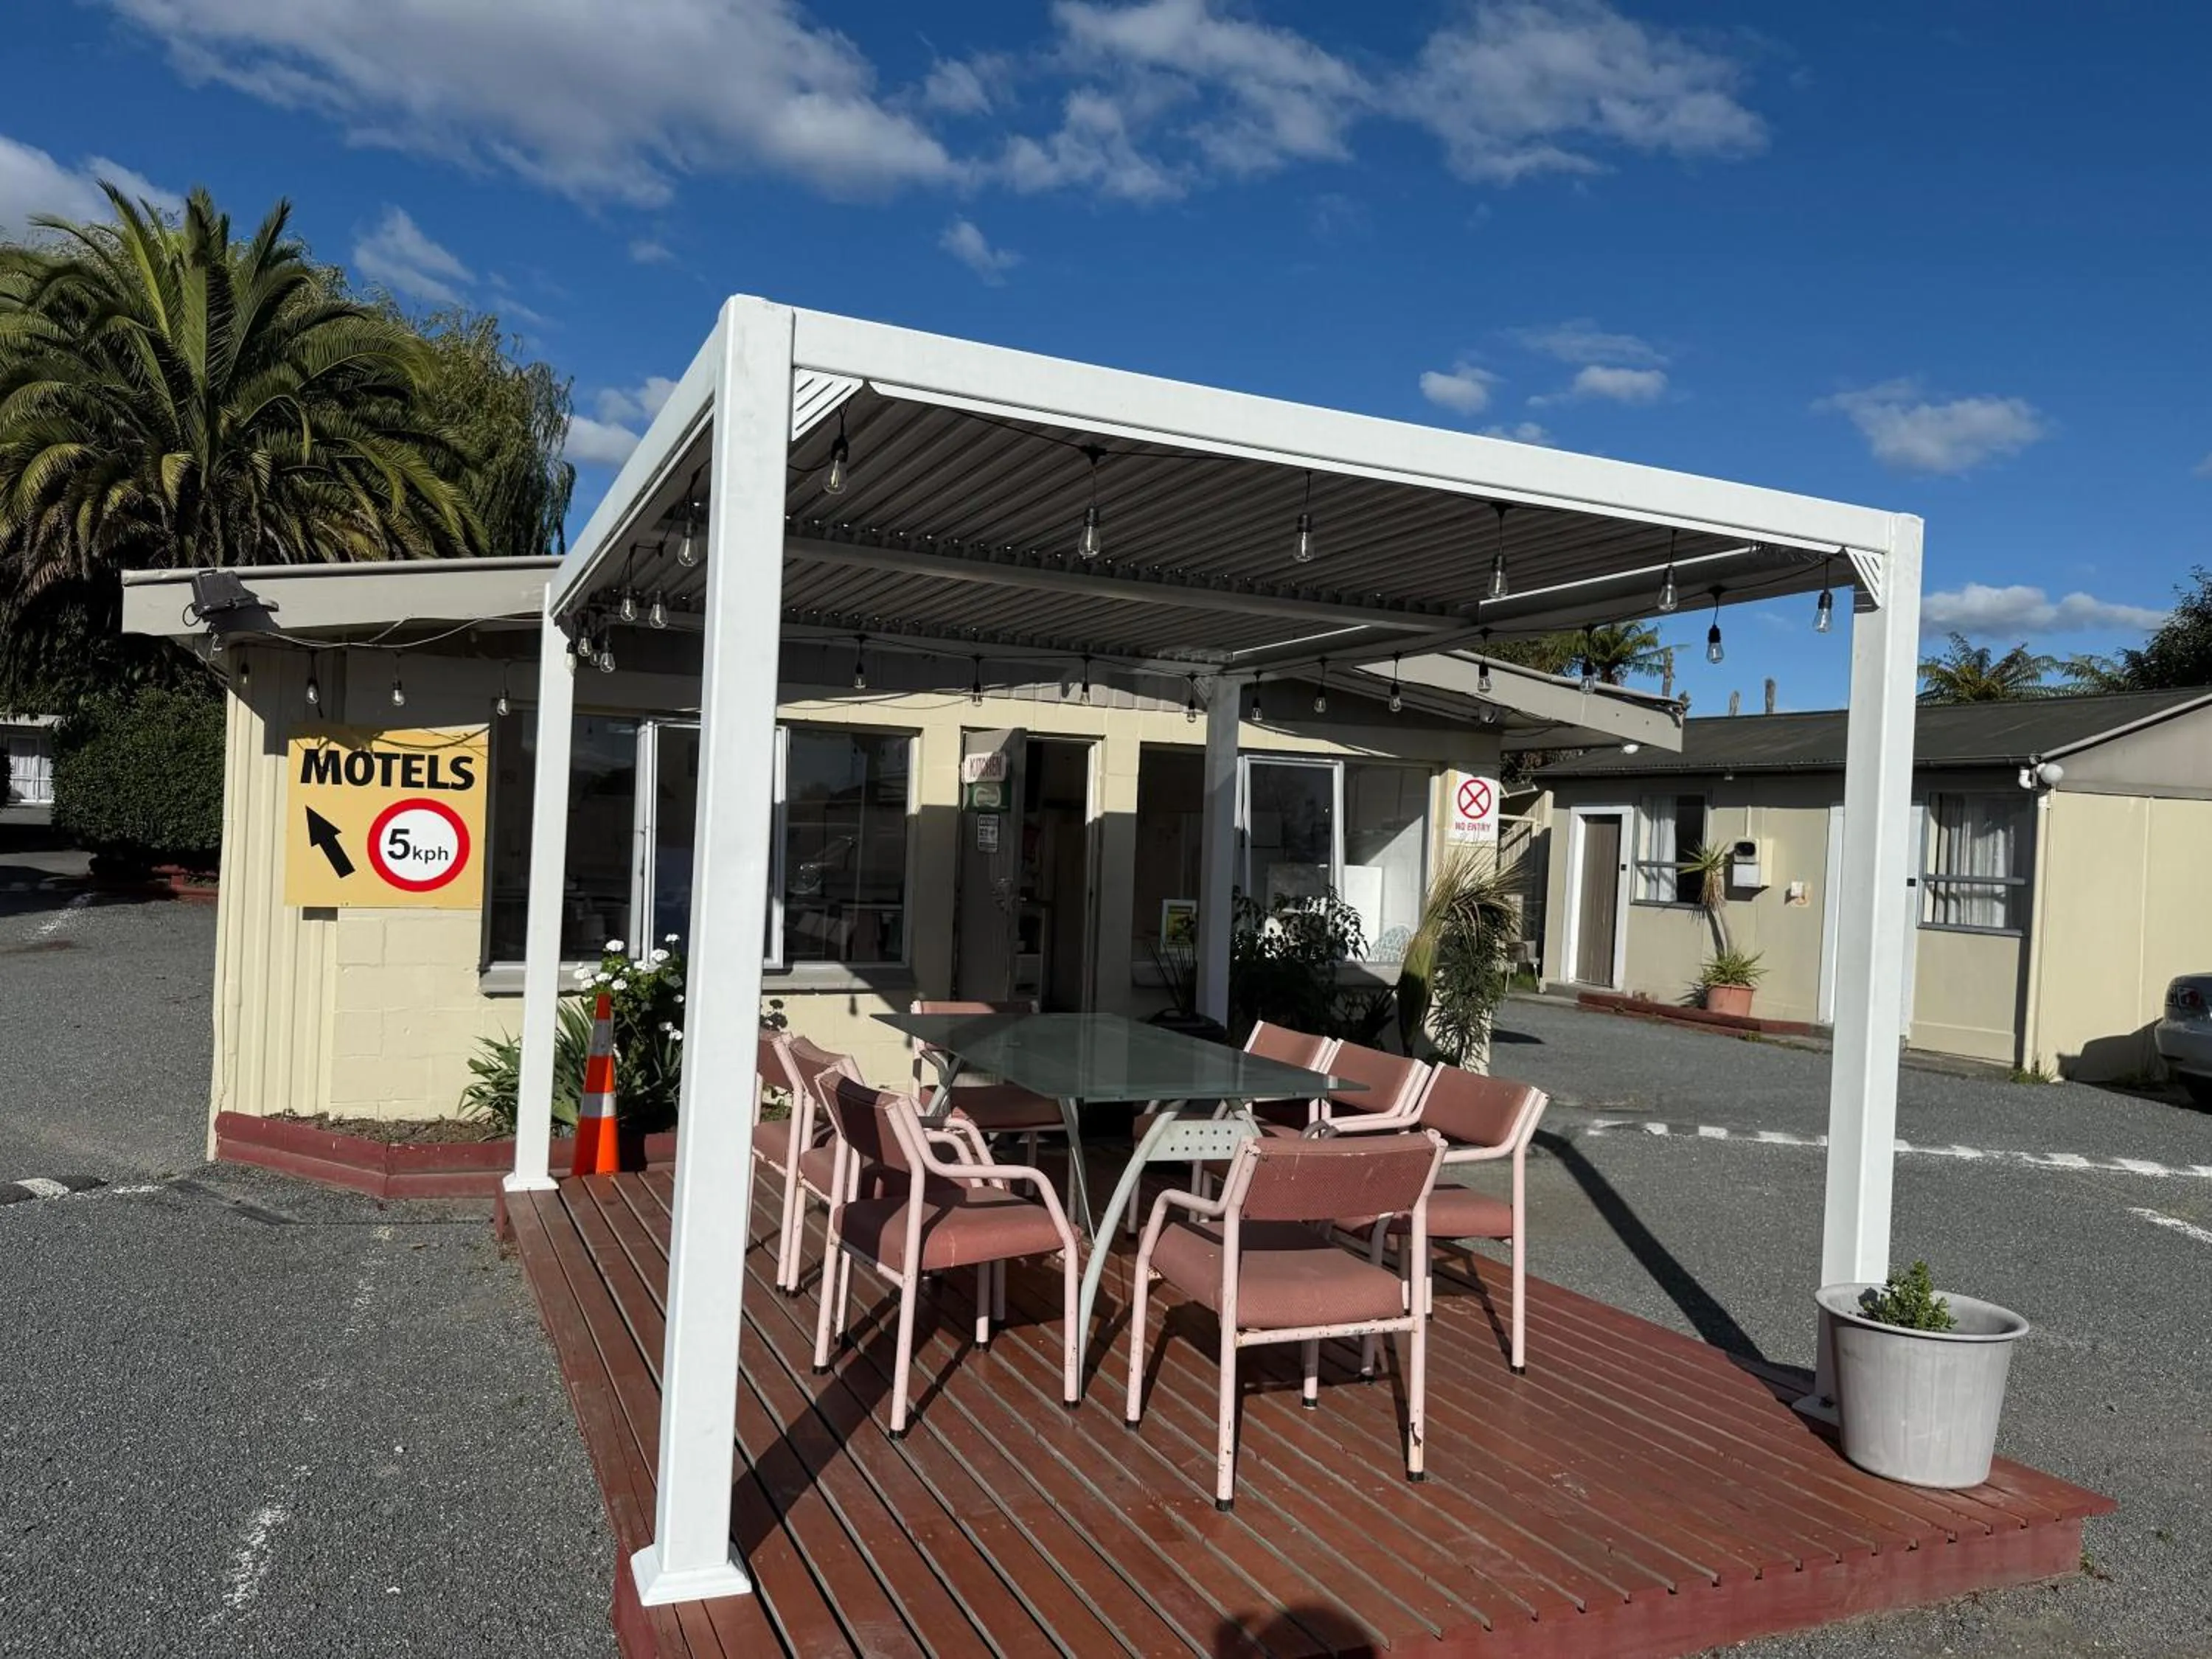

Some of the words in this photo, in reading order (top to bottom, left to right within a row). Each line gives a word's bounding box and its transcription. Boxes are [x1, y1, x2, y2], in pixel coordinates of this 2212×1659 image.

[300, 748, 476, 790] MOTELS
[969, 756, 1003, 777] KITCHEN
[1455, 821, 1466, 831] NO
[1467, 822, 1492, 832] ENTRY
[388, 829, 448, 864] 5kph
